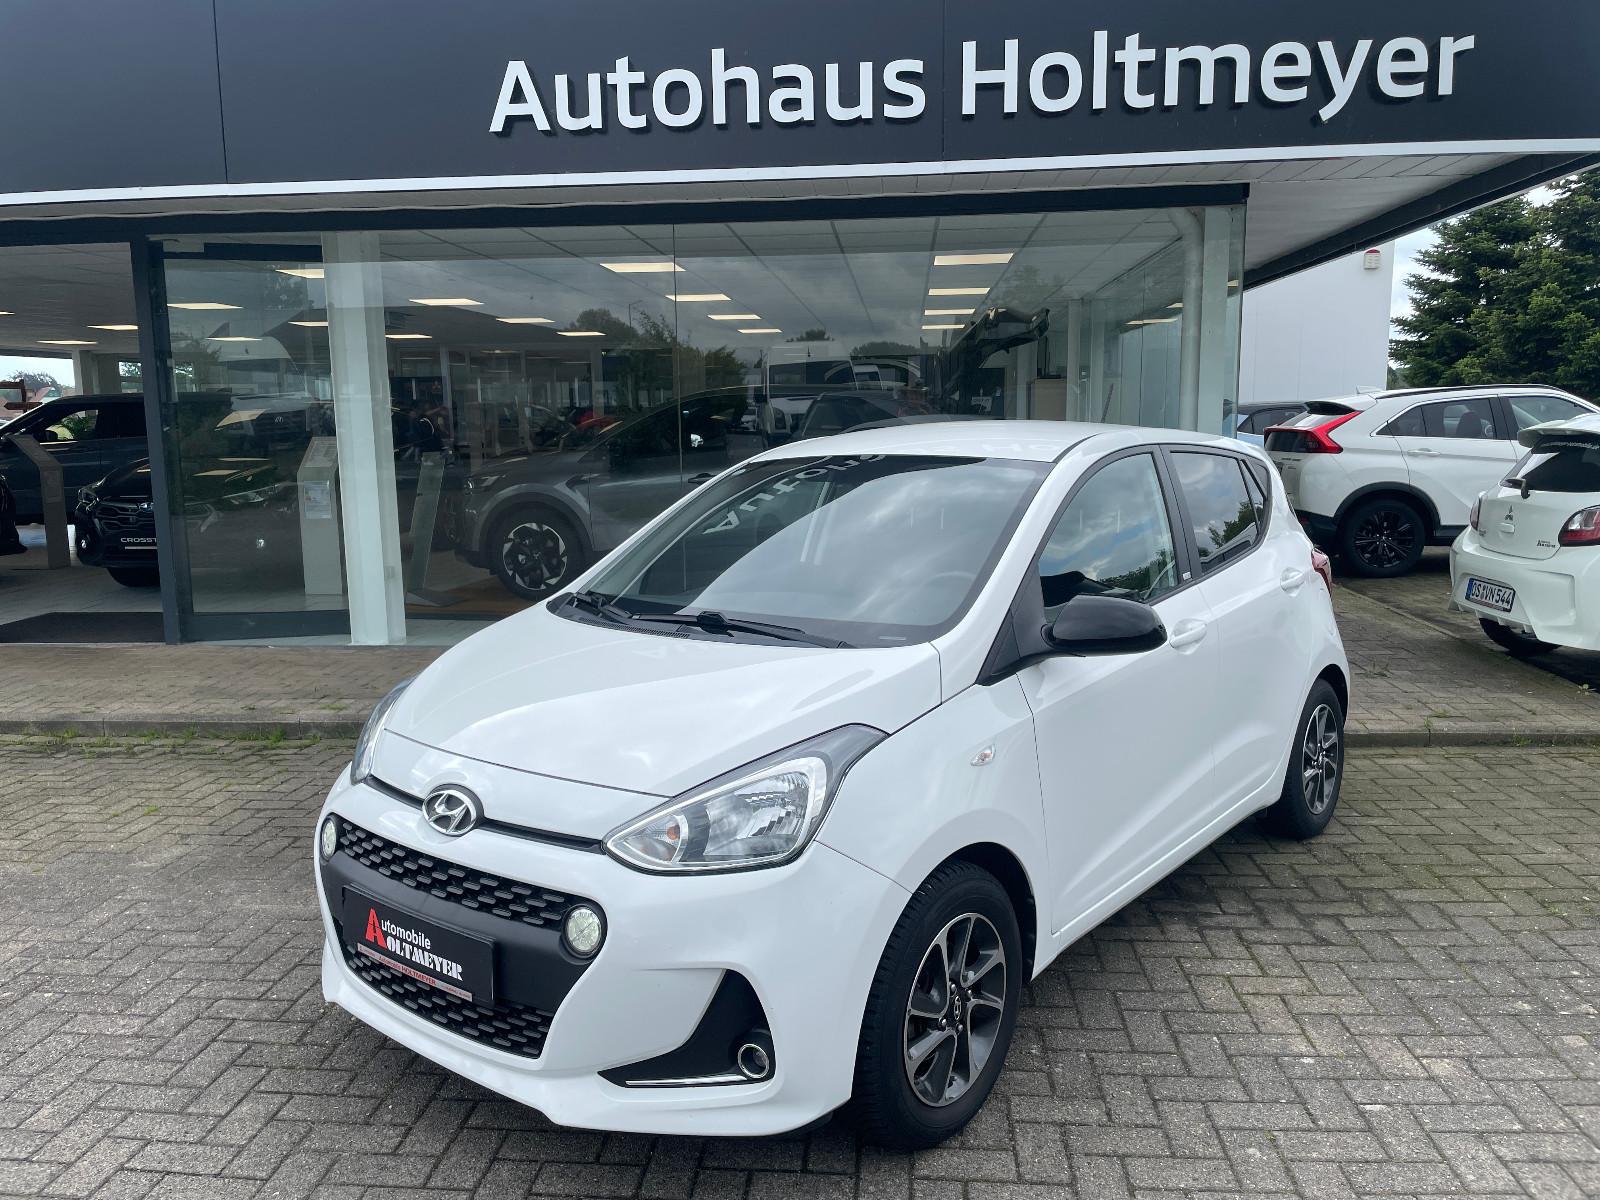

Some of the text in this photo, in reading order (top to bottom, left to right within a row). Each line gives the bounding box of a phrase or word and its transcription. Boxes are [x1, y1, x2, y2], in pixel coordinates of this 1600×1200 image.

[489, 30, 1475, 132] Autohaus Holtmeyer
[365, 907, 431, 949] Automobile
